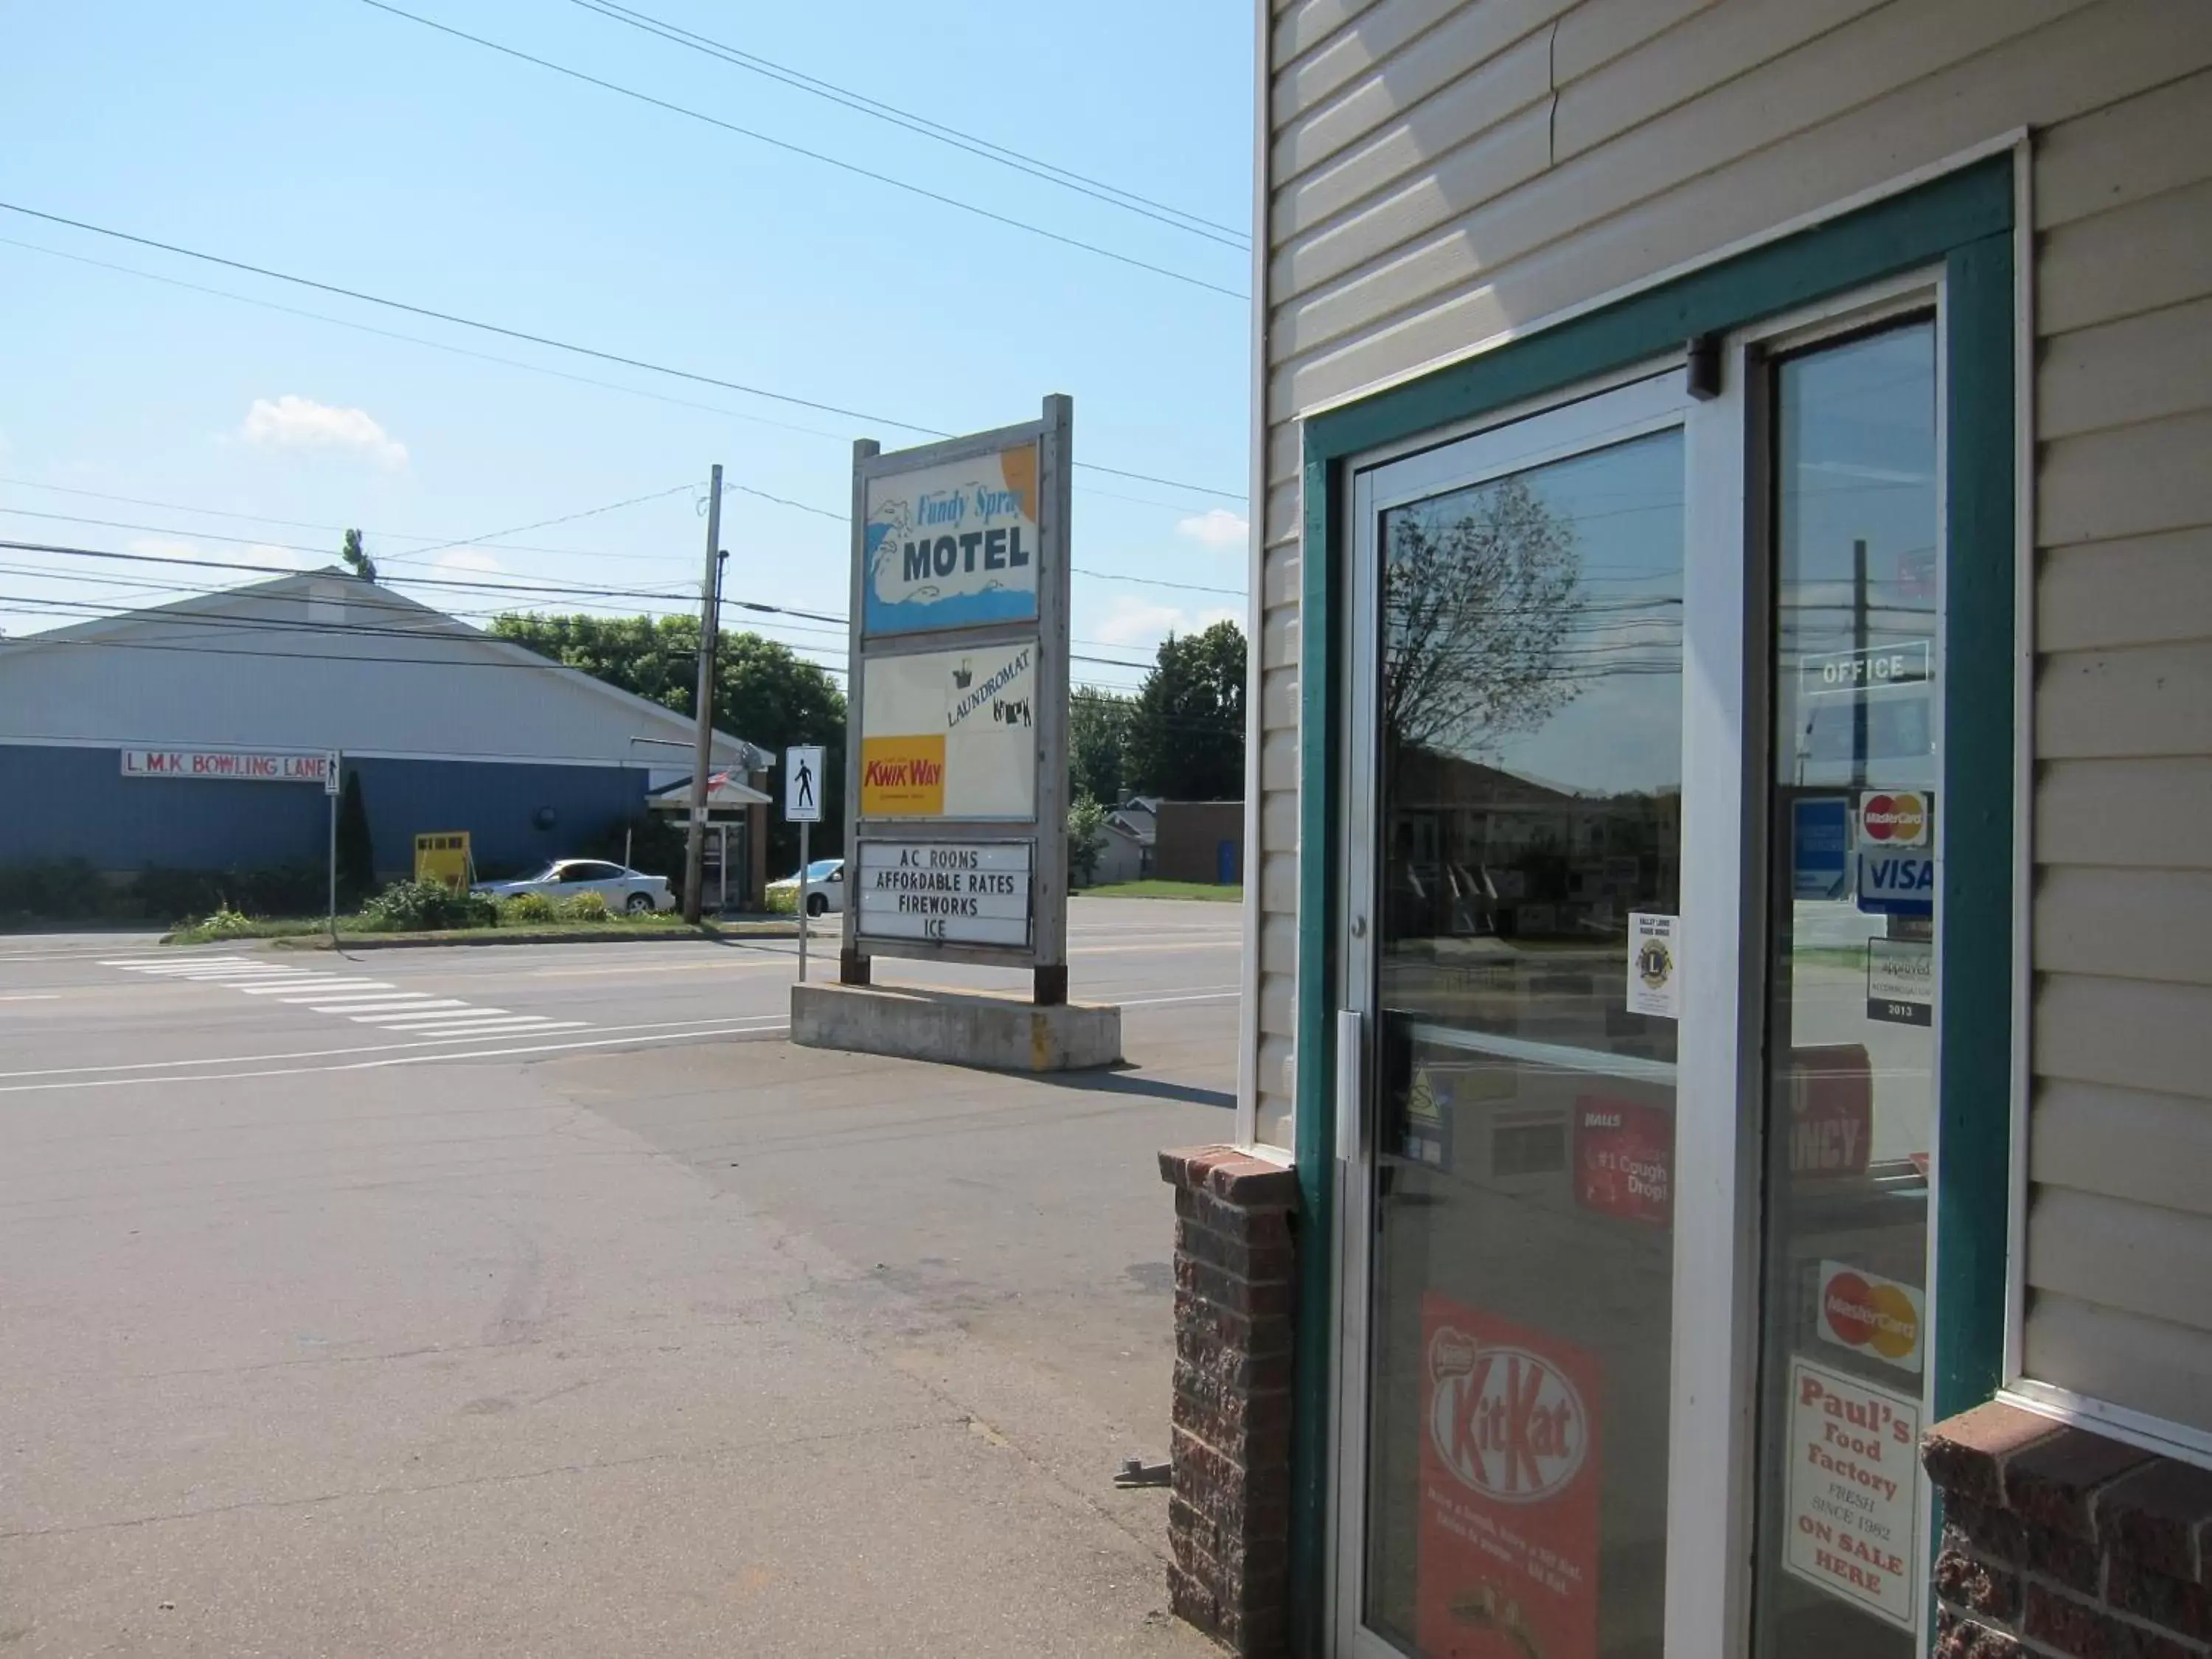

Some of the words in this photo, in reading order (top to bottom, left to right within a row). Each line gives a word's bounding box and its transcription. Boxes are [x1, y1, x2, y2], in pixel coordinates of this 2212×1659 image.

[917, 489, 970, 528] Fundy
[904, 526, 1029, 582] MOTEL
[1823, 655, 1905, 684] OFFICE
[948, 649, 1029, 728] LAUNDROMAT
[192, 754, 278, 776] BOWLING
[1865, 812, 1922, 825] MasterCard
[931, 851, 978, 869] ROOMS
[1871, 859, 1933, 891] VISA
[877, 871, 961, 891] AFFORDABLE
[970, 874, 1015, 894] RATES
[899, 894, 978, 916] FIREWORKS
[925, 920, 947, 937] ICE
[1888, 1004, 1913, 1017] 2013
[1585, 1113, 1621, 1128] HALLS
[1618, 1155, 1668, 1182] Cough
[1827, 1295, 1916, 1338] MasterCard
[1801, 1376, 1910, 1444] Paul's
[1824, 1421, 1882, 1462] Food
[1808, 1443, 1898, 1502] Factory
[1829, 1482, 1875, 1513] FRESH
[1812, 1495, 1854, 1526] SINCE
[1859, 1515, 1891, 1541] 1982
[1798, 1515, 1832, 1543] ON
[1838, 1533, 1905, 1576] SALE
[1815, 1549, 1882, 1595] HERE
